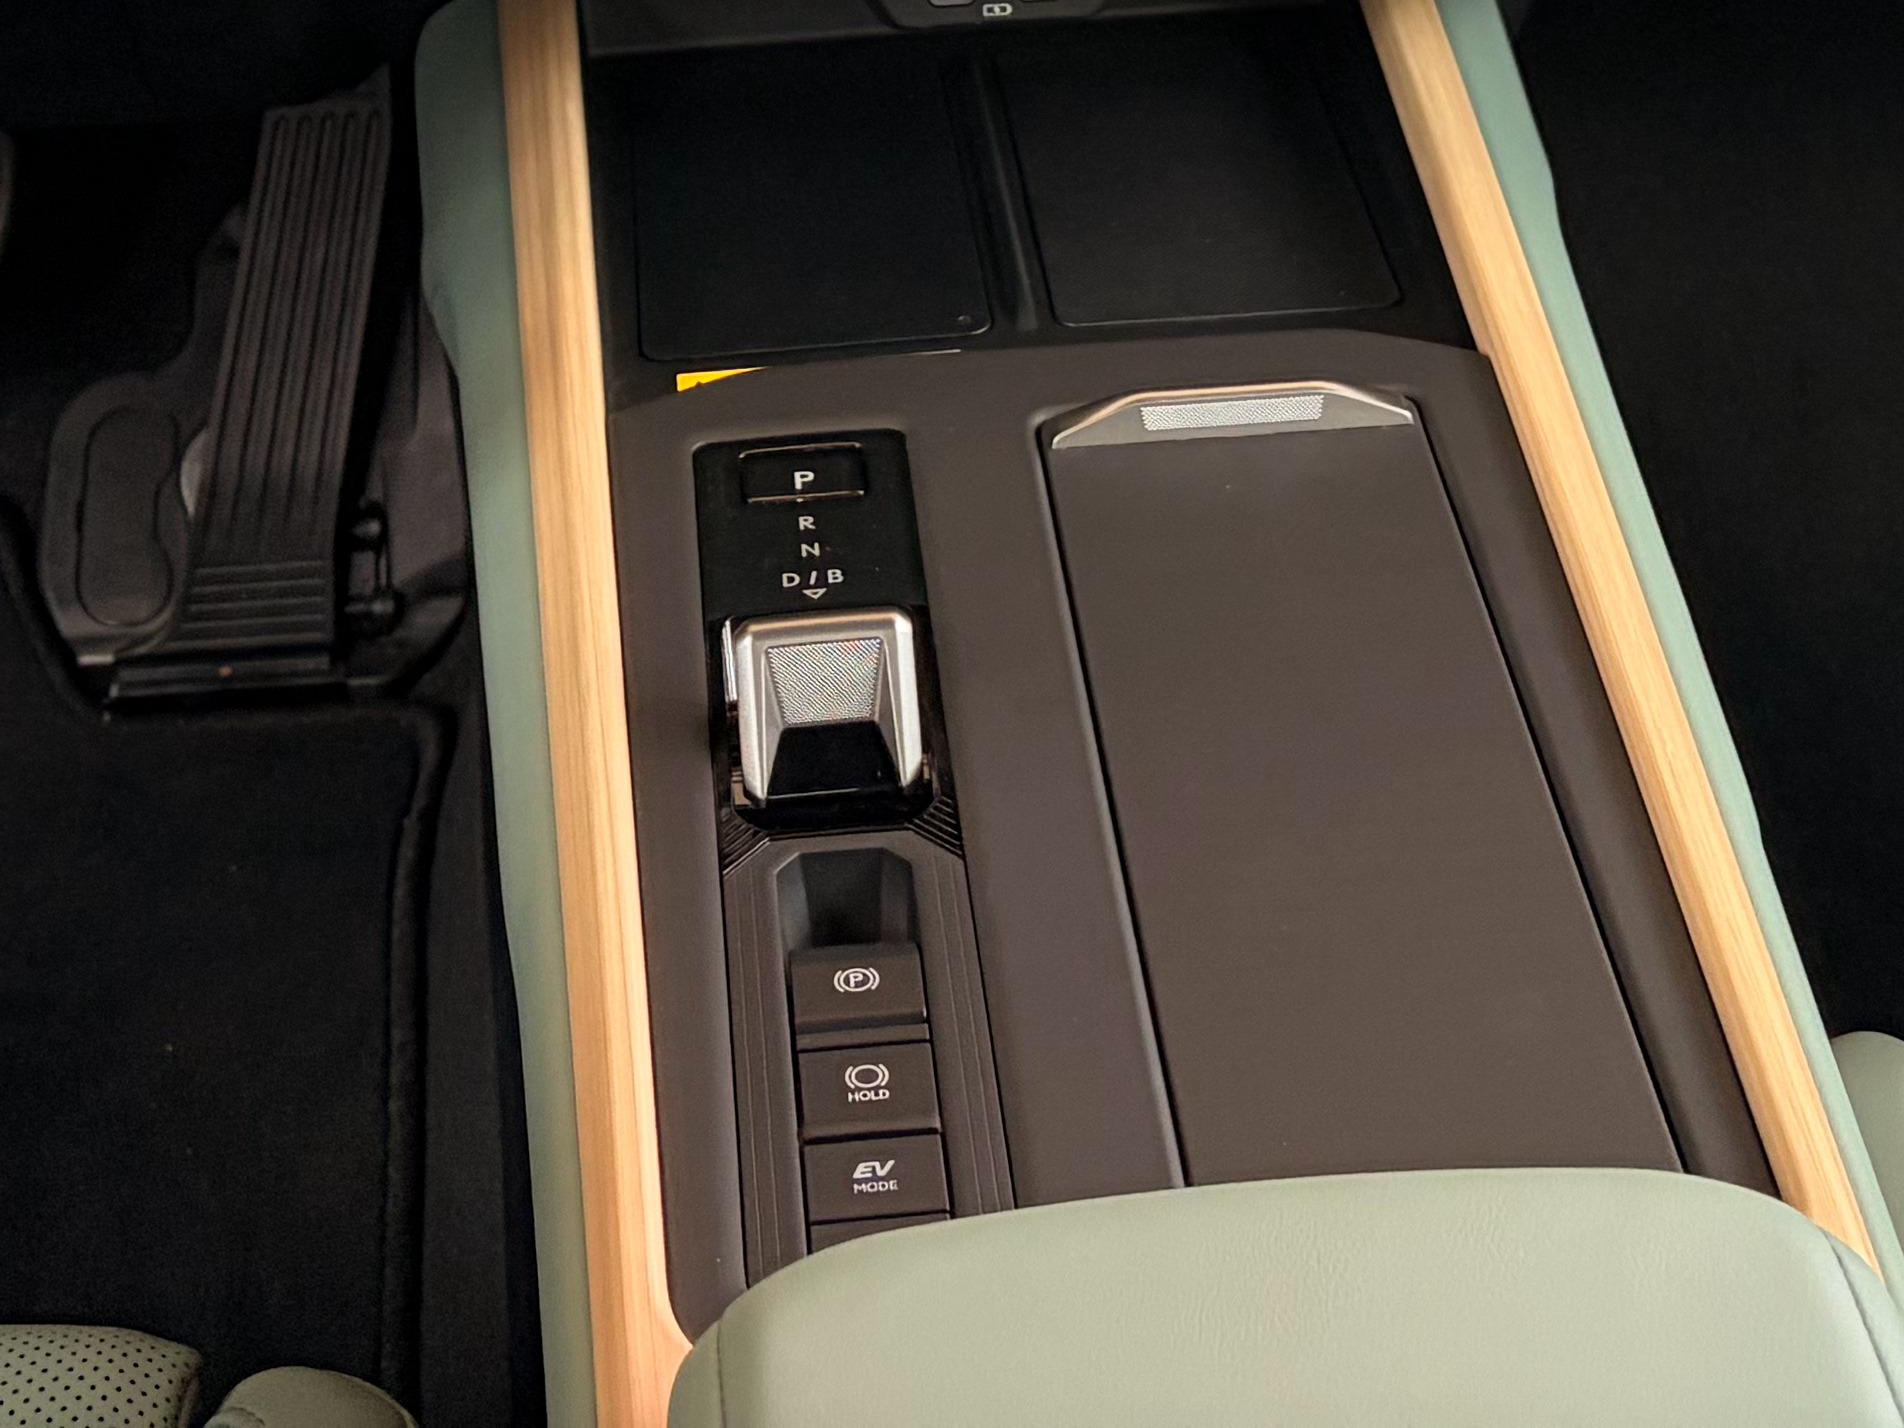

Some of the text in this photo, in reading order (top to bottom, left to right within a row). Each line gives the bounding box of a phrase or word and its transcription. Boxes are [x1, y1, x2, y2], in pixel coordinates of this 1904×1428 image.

[794, 470, 815, 490] P
[798, 515, 816, 532] R
[801, 542, 820, 558] N
[848, 1089, 890, 1103] HOLD
[853, 1160, 895, 1178] EV
[853, 1180, 898, 1194] MODE
